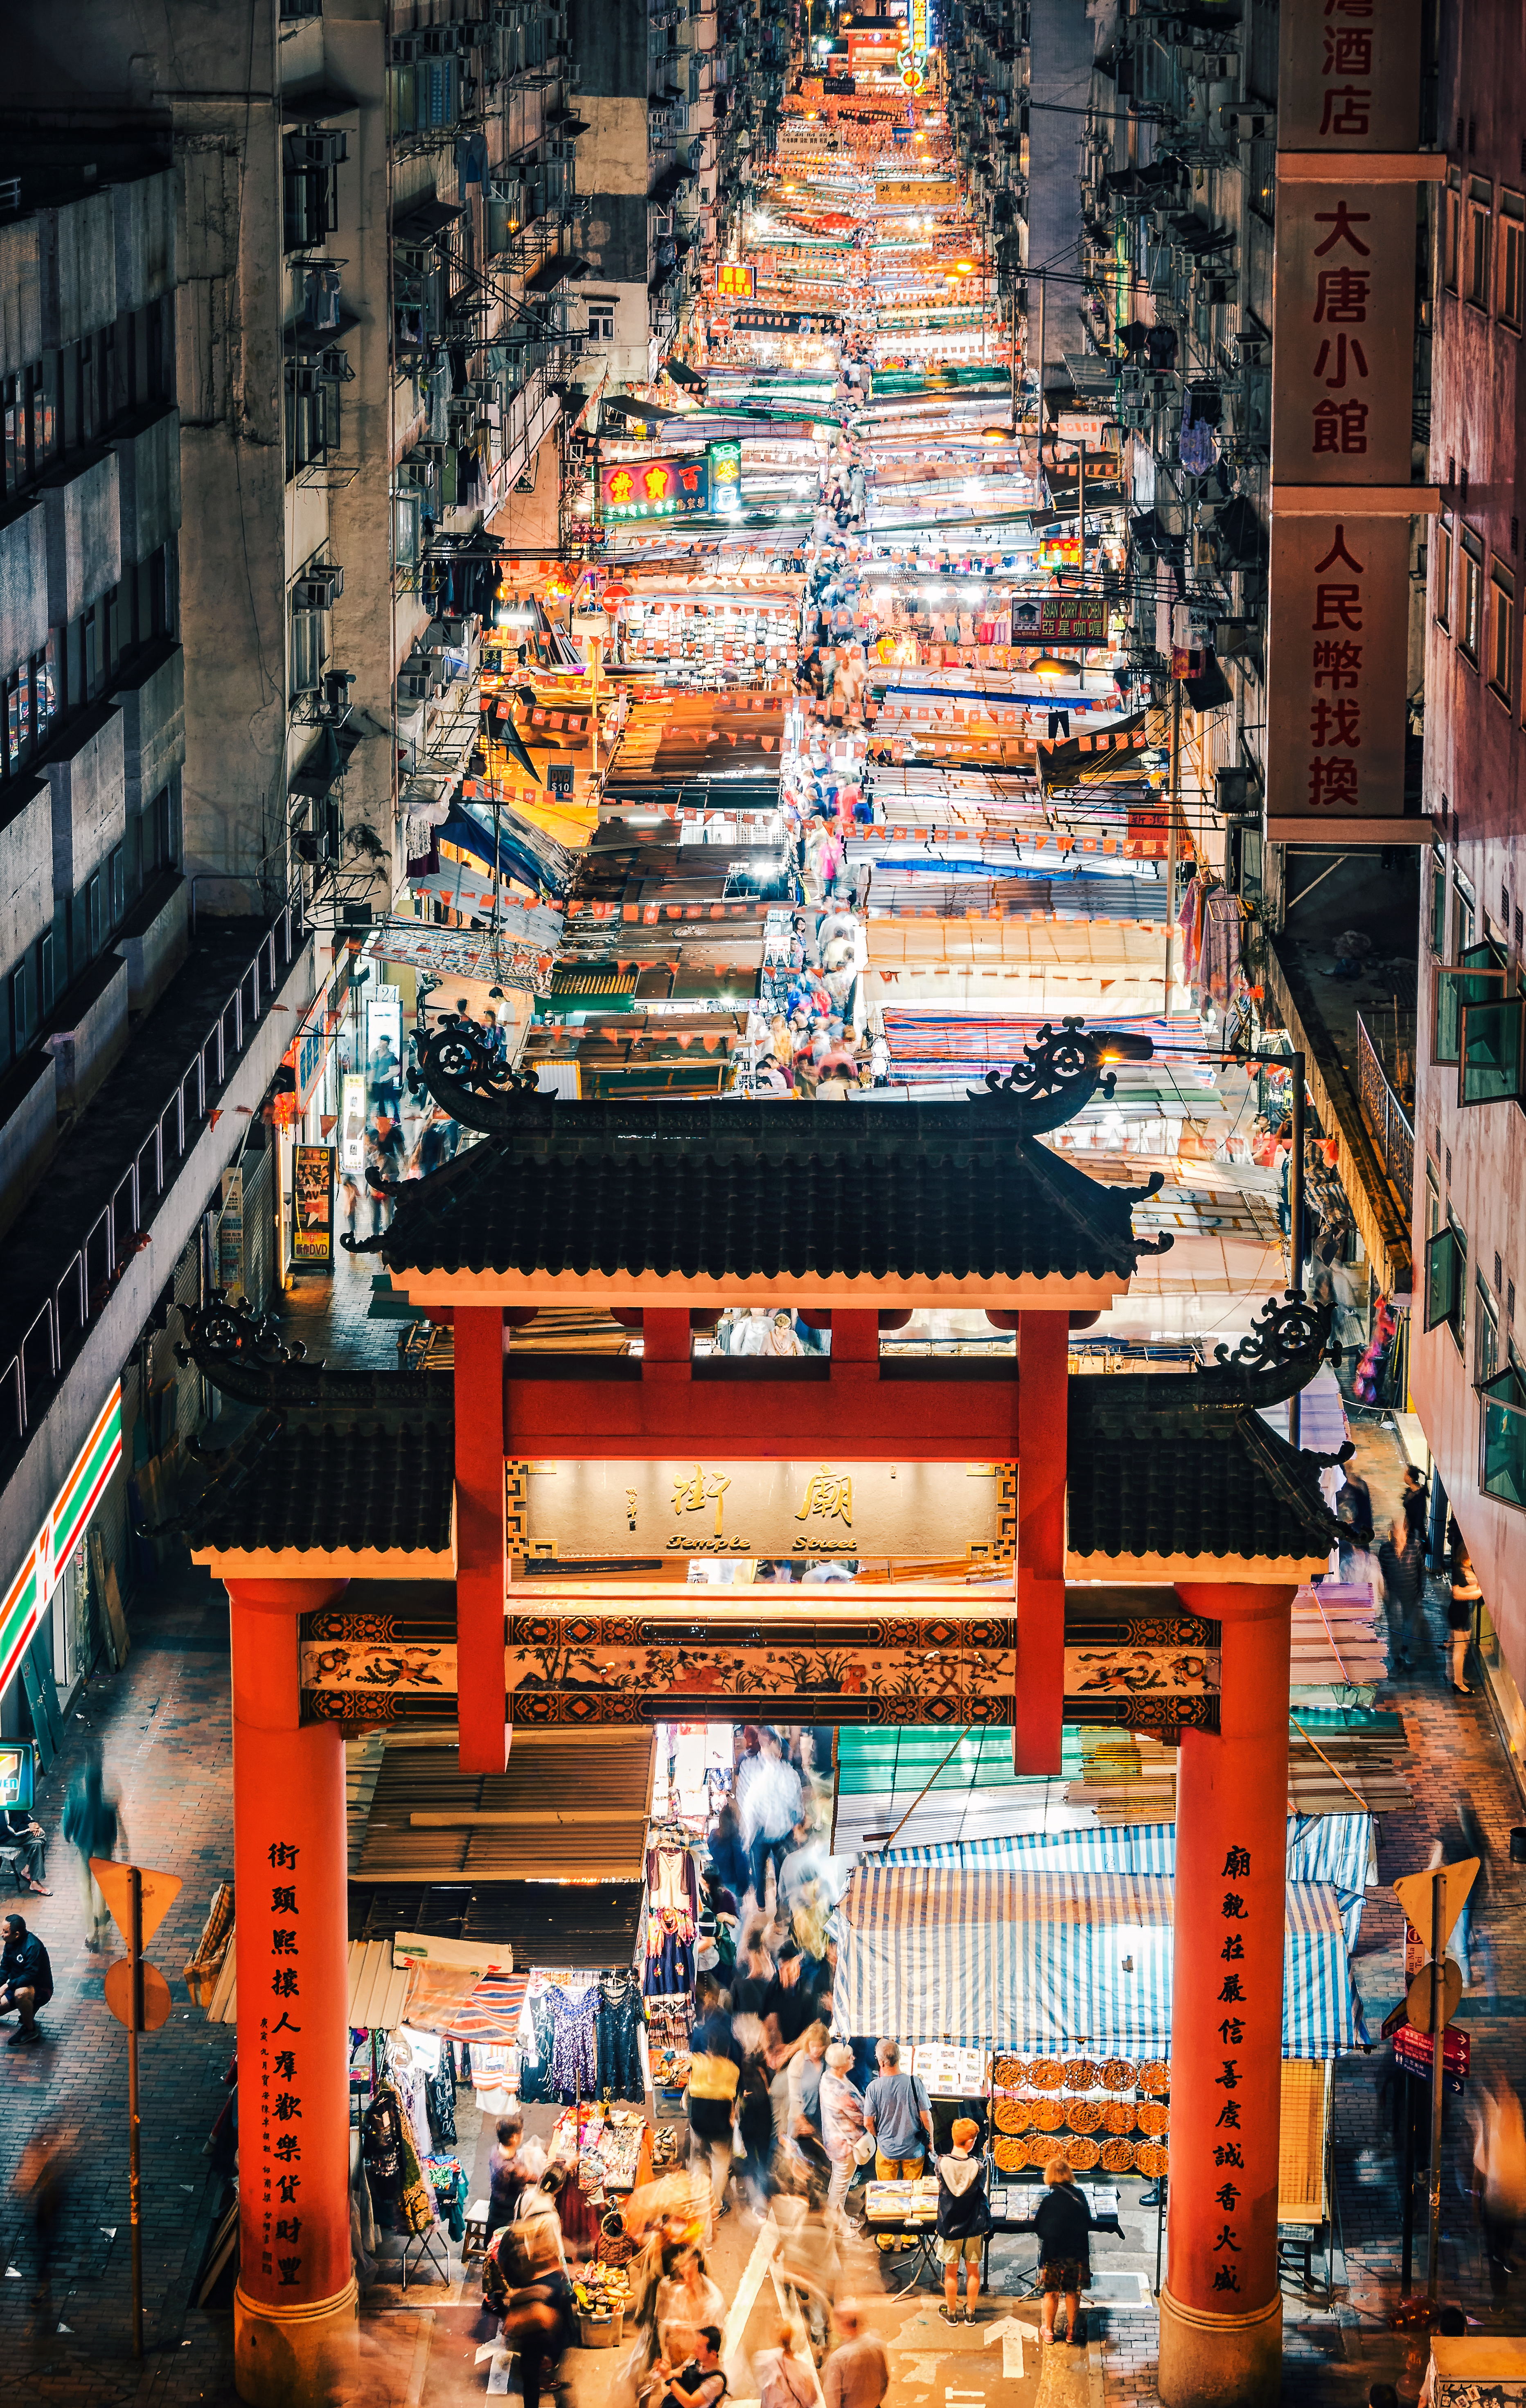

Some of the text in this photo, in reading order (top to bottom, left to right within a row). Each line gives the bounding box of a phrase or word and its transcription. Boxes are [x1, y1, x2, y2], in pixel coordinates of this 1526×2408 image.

[1312, 200, 1371, 454] 大唐小館
[1042, 602, 1102, 619] ASIAN CURRY KITCHEN
[1309, 523, 1364, 806] 人民幣找換
[551, 770, 570, 782] DVD
[551, 782, 569, 792] $10
[374, 986, 397, 1003] 124
[306, 1190, 319, 1200] AV
[670, 1463, 854, 1537] 廟街
[665, 1534, 857, 1551] Temple Street
[1407, 1947, 1415, 1959] Ma
[1404, 2063, 1426, 2078] Public Toilet
